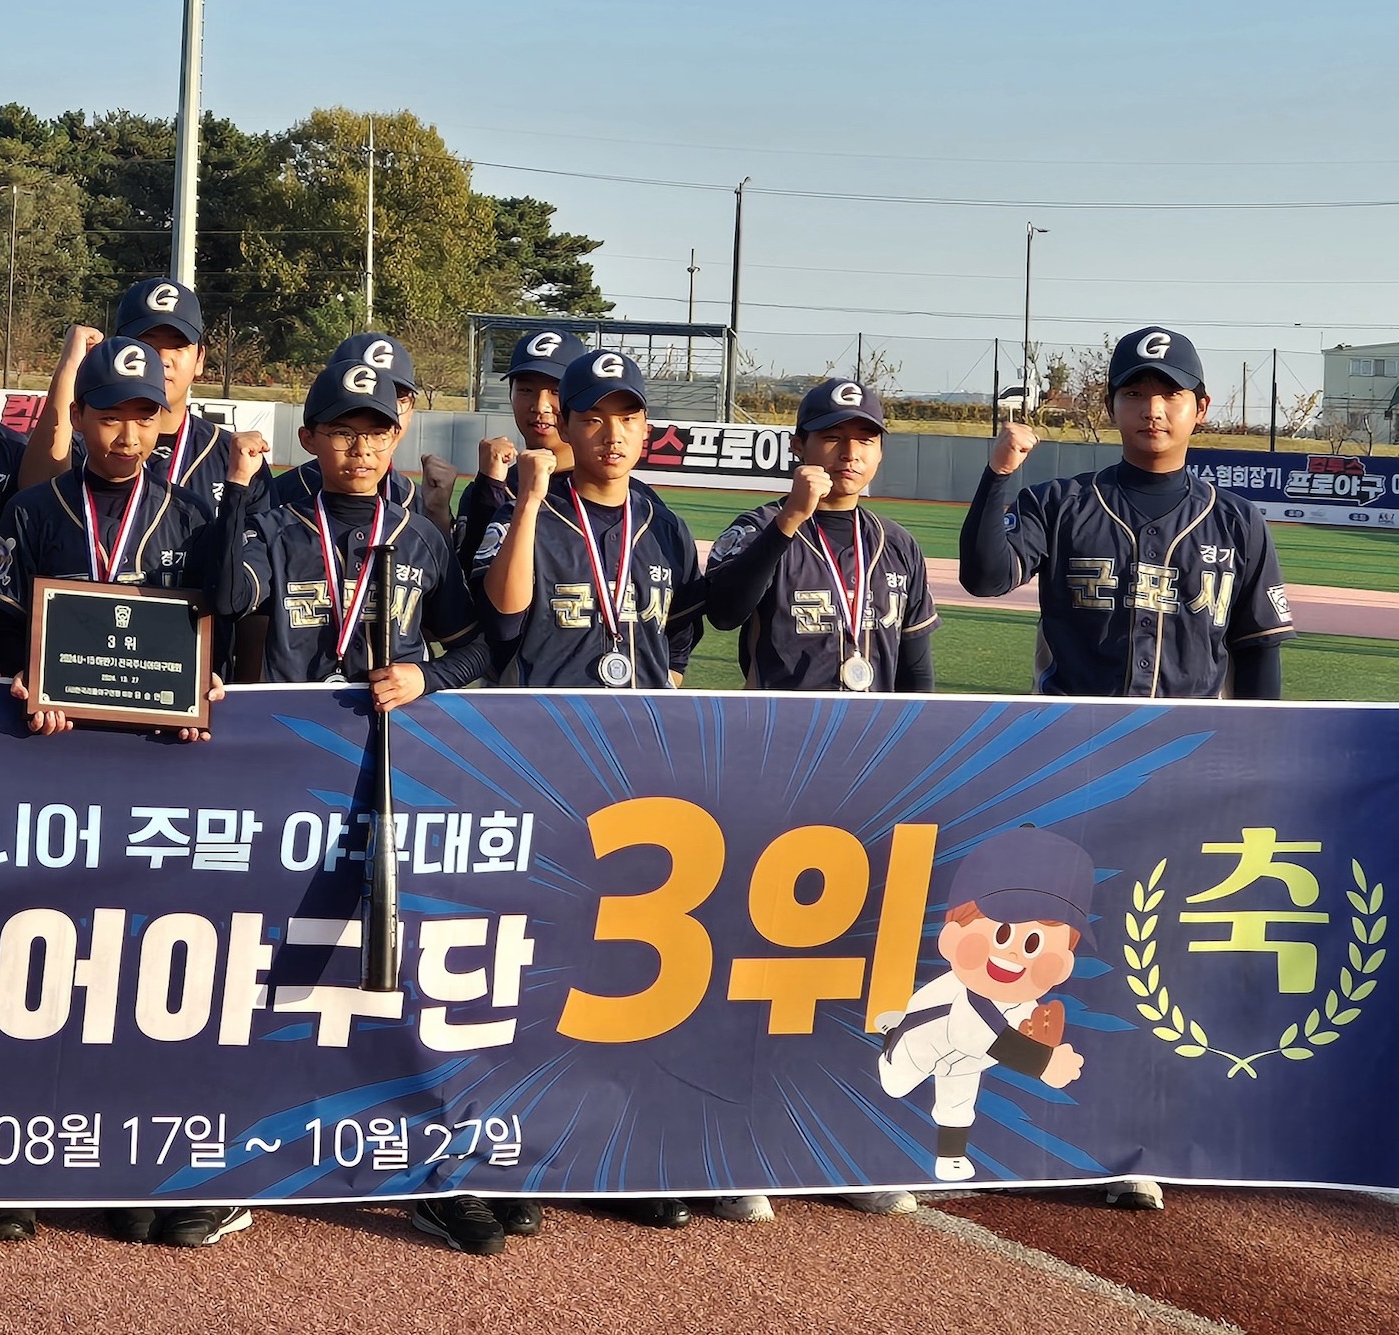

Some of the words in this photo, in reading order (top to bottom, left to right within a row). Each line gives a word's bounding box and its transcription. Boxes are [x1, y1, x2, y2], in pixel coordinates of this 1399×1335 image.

[146, 283, 179, 312] G
[363, 339, 394, 369] G
[526, 332, 563, 358] G
[1136, 332, 1171, 360] G
[113, 345, 147, 378] G
[592, 353, 625, 379] G
[342, 365, 378, 395] G
[831, 382, 863, 407] G
[1287, 472, 1385, 500] 프로야구
[1200, 545, 1235, 568] 경기
[396, 564, 423, 585] 경기
[649, 565, 673, 585] 경기
[1066, 558, 1235, 627] 군포시
[107, 635, 116, 649] 3
[124, 636, 137, 651] 위
[125, 806, 263, 872] 주말
[556, 796, 938, 1044] 3위
[1179, 827, 1330, 994] 축
[123, 1113, 227, 1168] 17일
[305, 1117, 409, 1170] 10월
[423, 1114, 522, 1167] 27일
